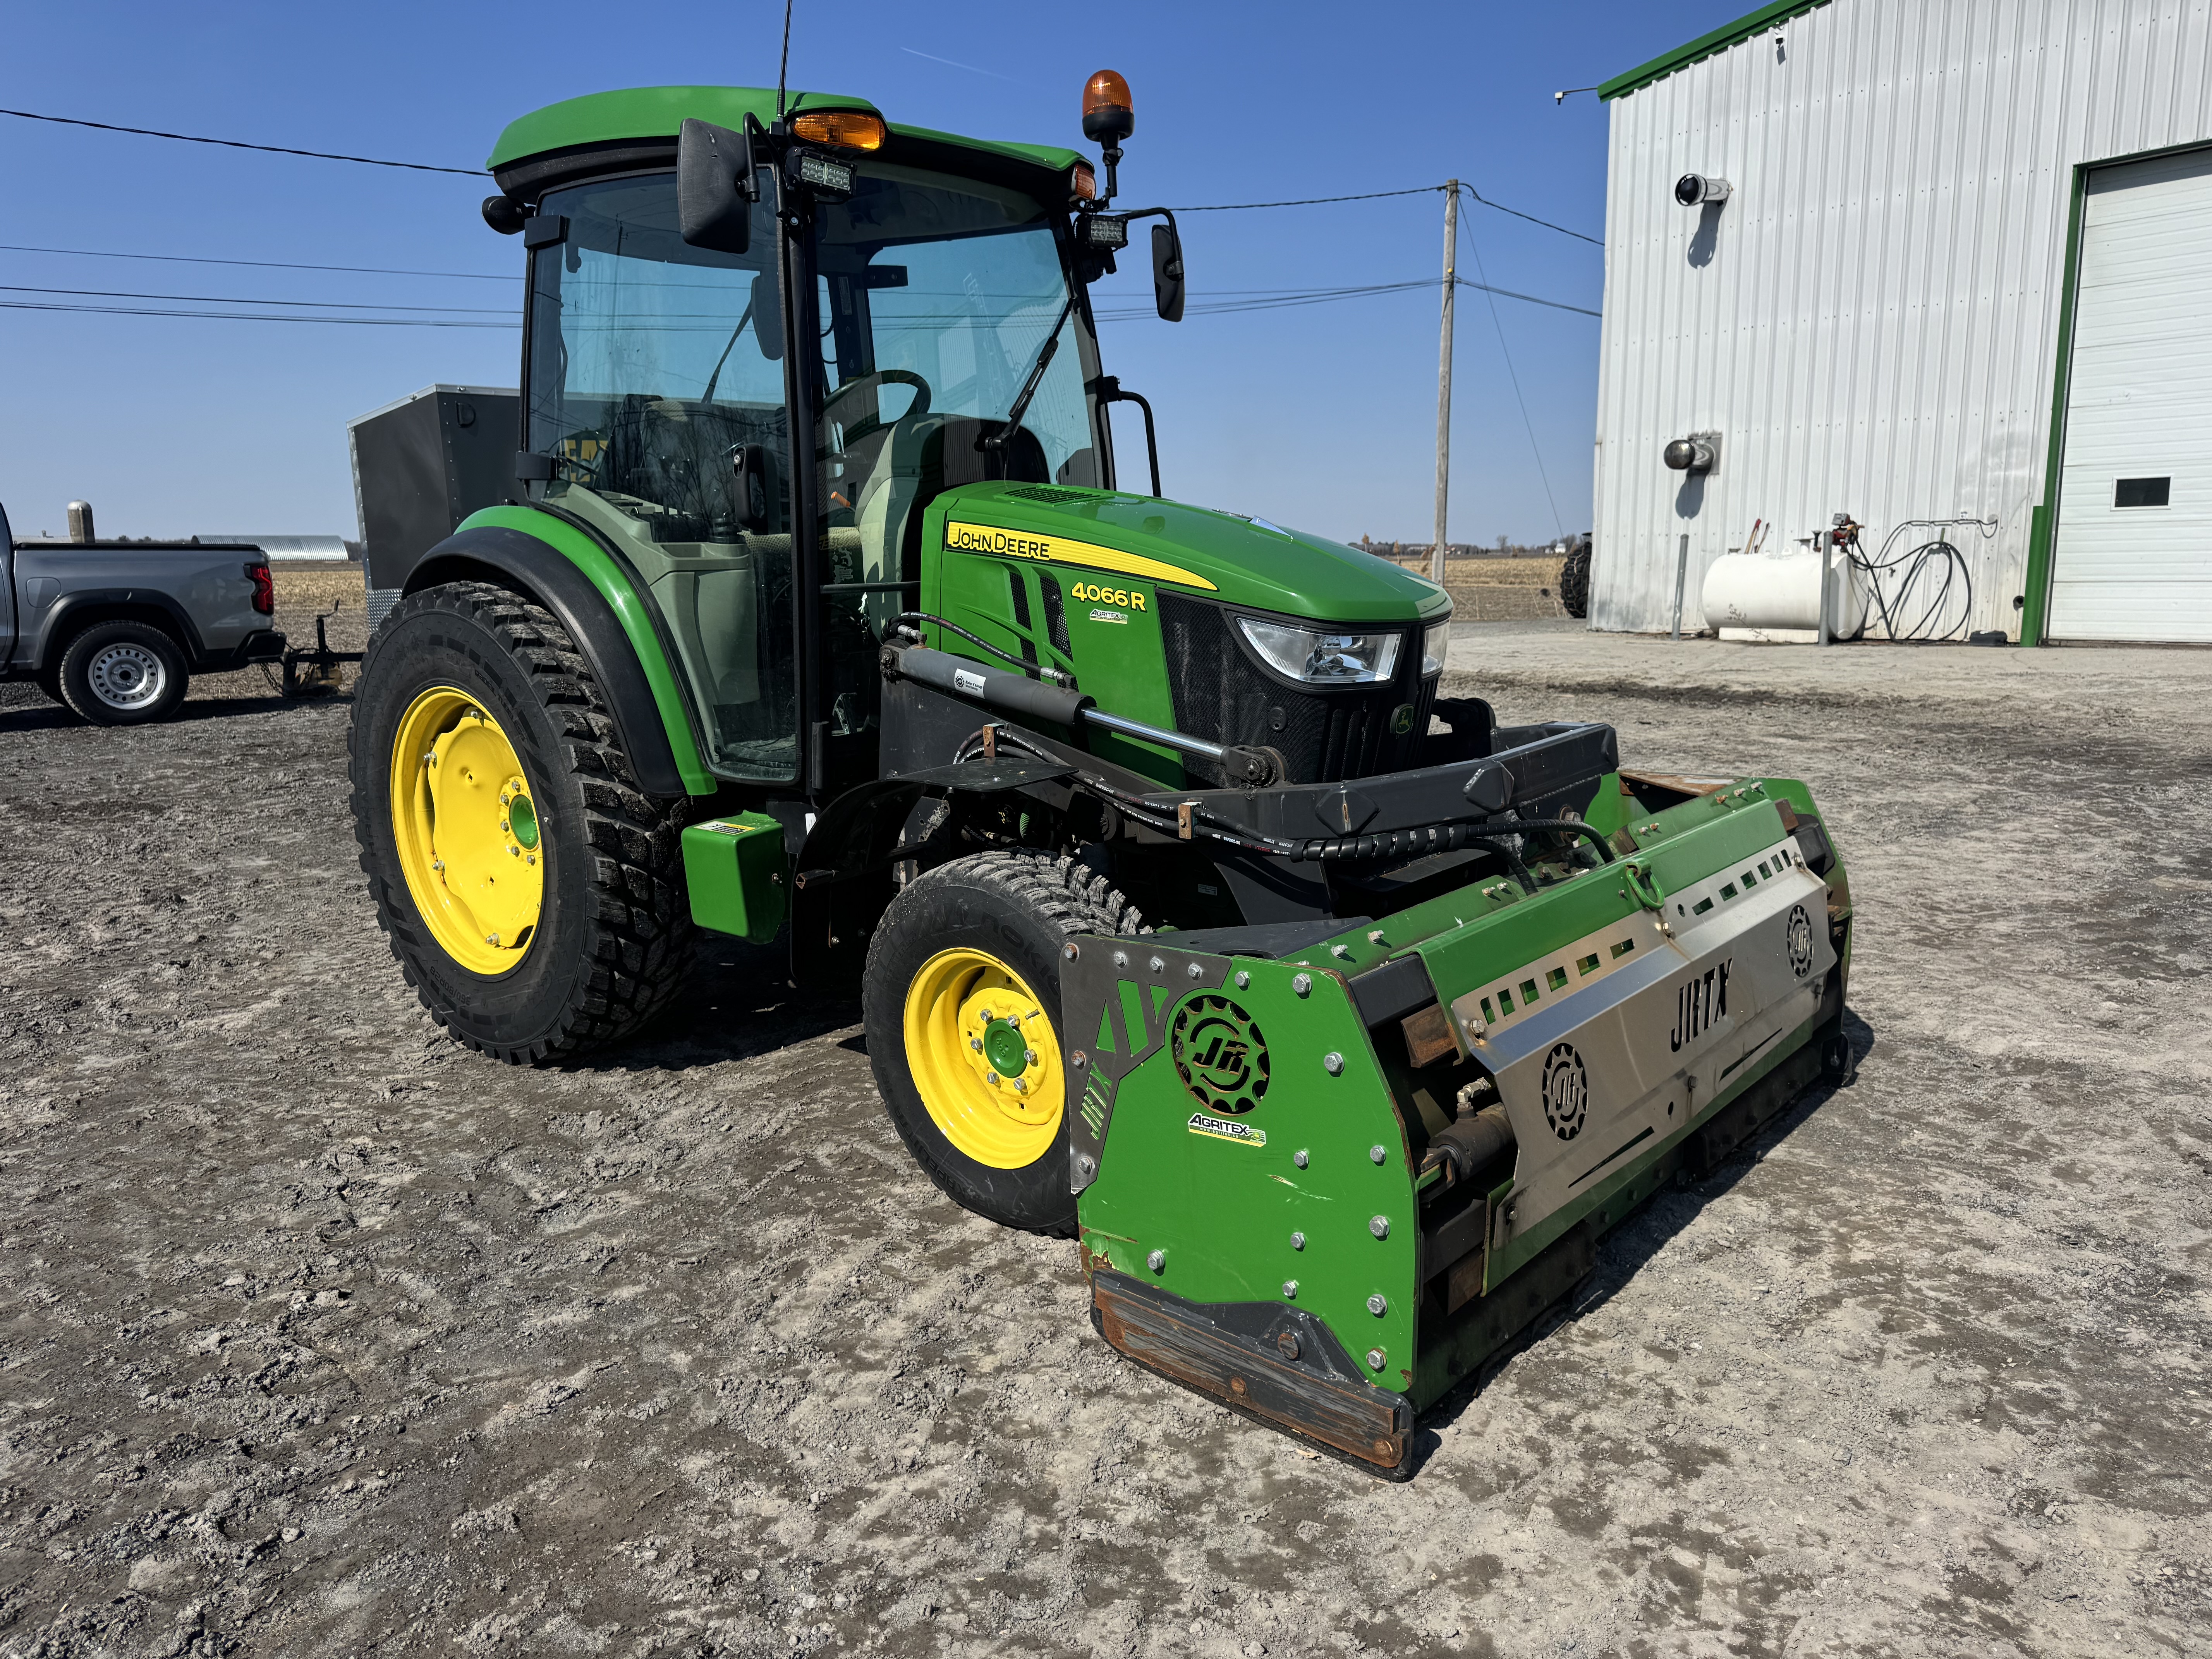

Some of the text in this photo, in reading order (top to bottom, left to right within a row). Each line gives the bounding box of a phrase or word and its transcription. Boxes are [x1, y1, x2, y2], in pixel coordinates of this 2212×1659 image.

[953, 528, 1050, 558] JOHN DEERE
[1072, 582, 1146, 611] 4066R
[1091, 610, 1119, 618] AGRITEX
[1671, 956, 1733, 1053] JRTX
[1192, 1036, 1249, 1075] JR
[1080, 1058, 1113, 1140] JRTX
[1190, 1114, 1248, 1135] AGRITEX
[1200, 1127, 1239, 1139] www.agritex.ca
